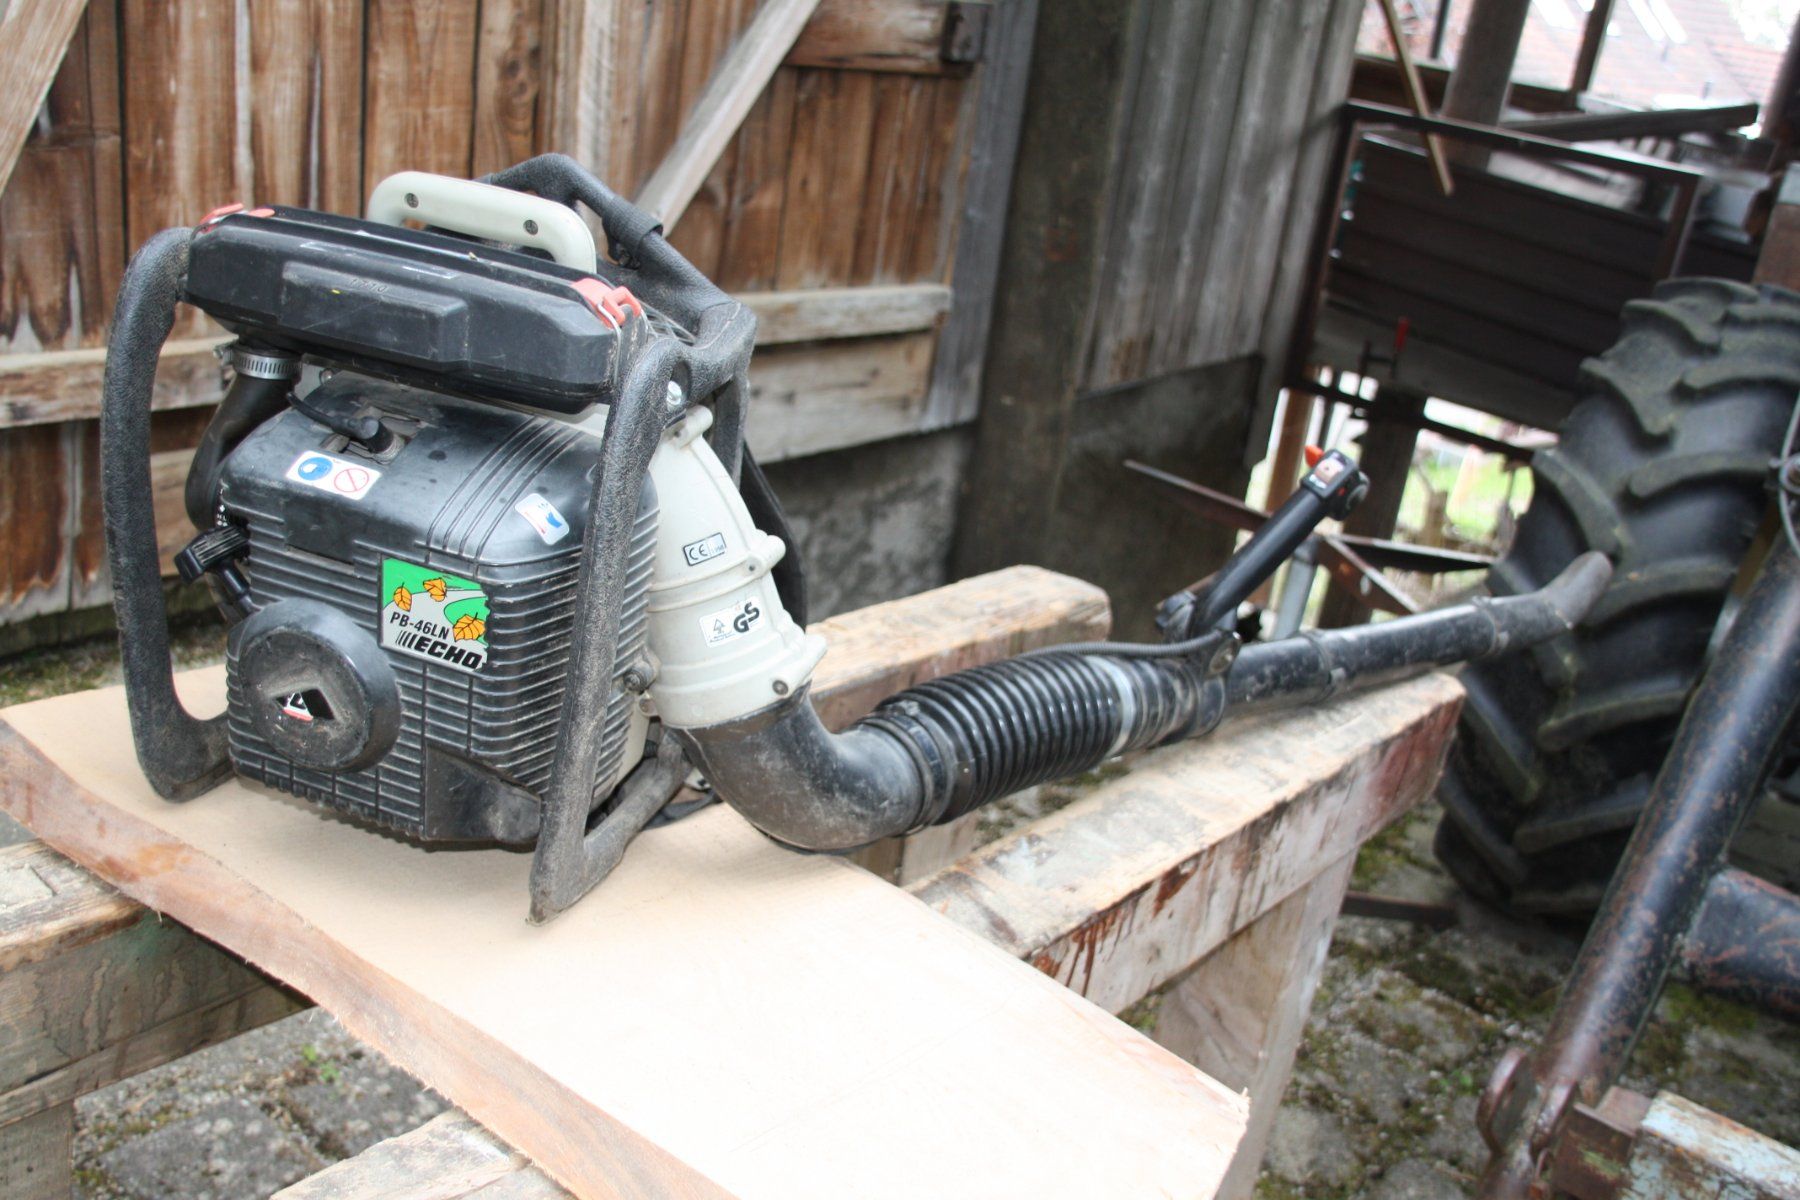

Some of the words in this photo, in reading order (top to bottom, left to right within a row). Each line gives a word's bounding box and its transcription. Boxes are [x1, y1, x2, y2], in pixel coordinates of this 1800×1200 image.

[689, 544, 708, 560] CE
[390, 612, 450, 640] PB-46LN
[733, 602, 760, 633] GS
[414, 636, 483, 669] ECHO
